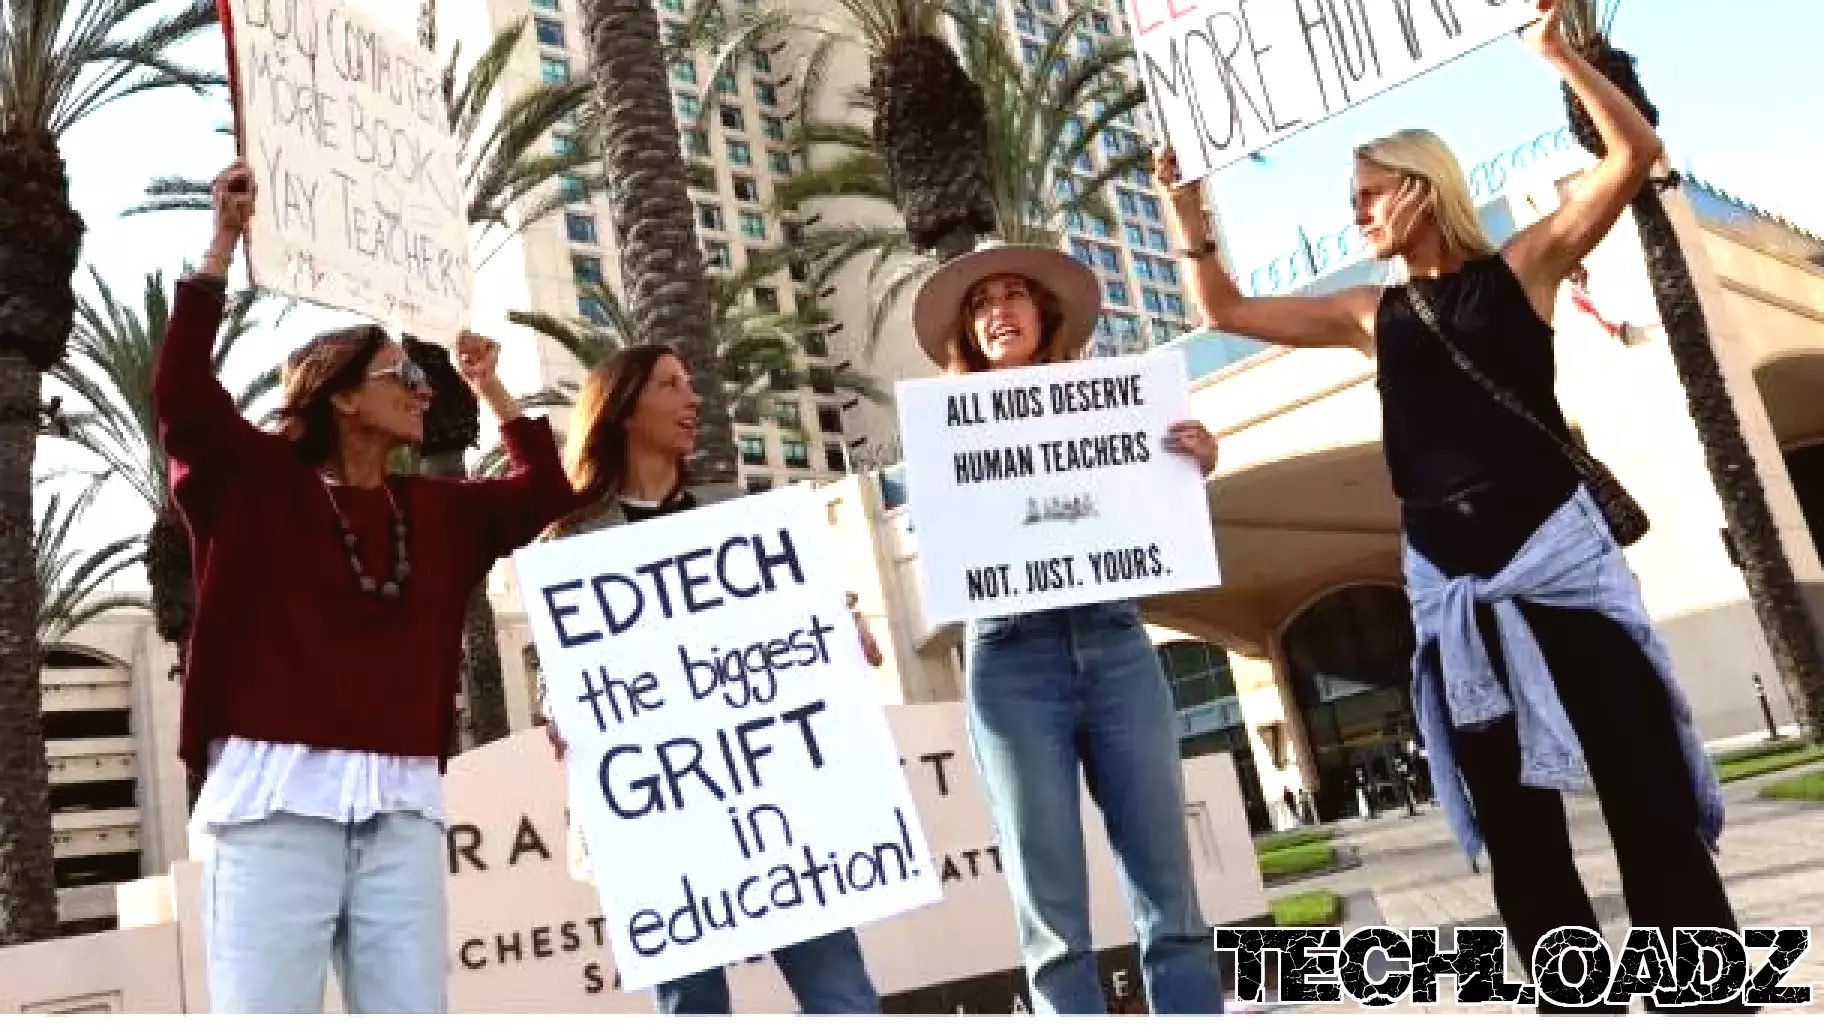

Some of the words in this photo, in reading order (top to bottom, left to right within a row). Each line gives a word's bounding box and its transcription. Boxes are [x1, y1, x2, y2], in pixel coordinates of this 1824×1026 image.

[1143, 0, 1302, 169] MORE
[258, 130, 317, 241] YAY
[947, 392, 986, 427] ALL
[990, 386, 1044, 422] KIDS
[1049, 374, 1145, 416] DESERVE
[953, 444, 1035, 485] HUMAN
[1039, 431, 1151, 474] TEACHERS
[542, 528, 805, 648] EDTECH
[965, 564, 1020, 602] NOT.
[1026, 554, 1084, 594] JUST.
[577, 664, 666, 732] the
[678, 614, 835, 709] biggest
[598, 700, 826, 819] GRIFT
[628, 806, 922, 956] education!
[728, 803, 793, 860] in
